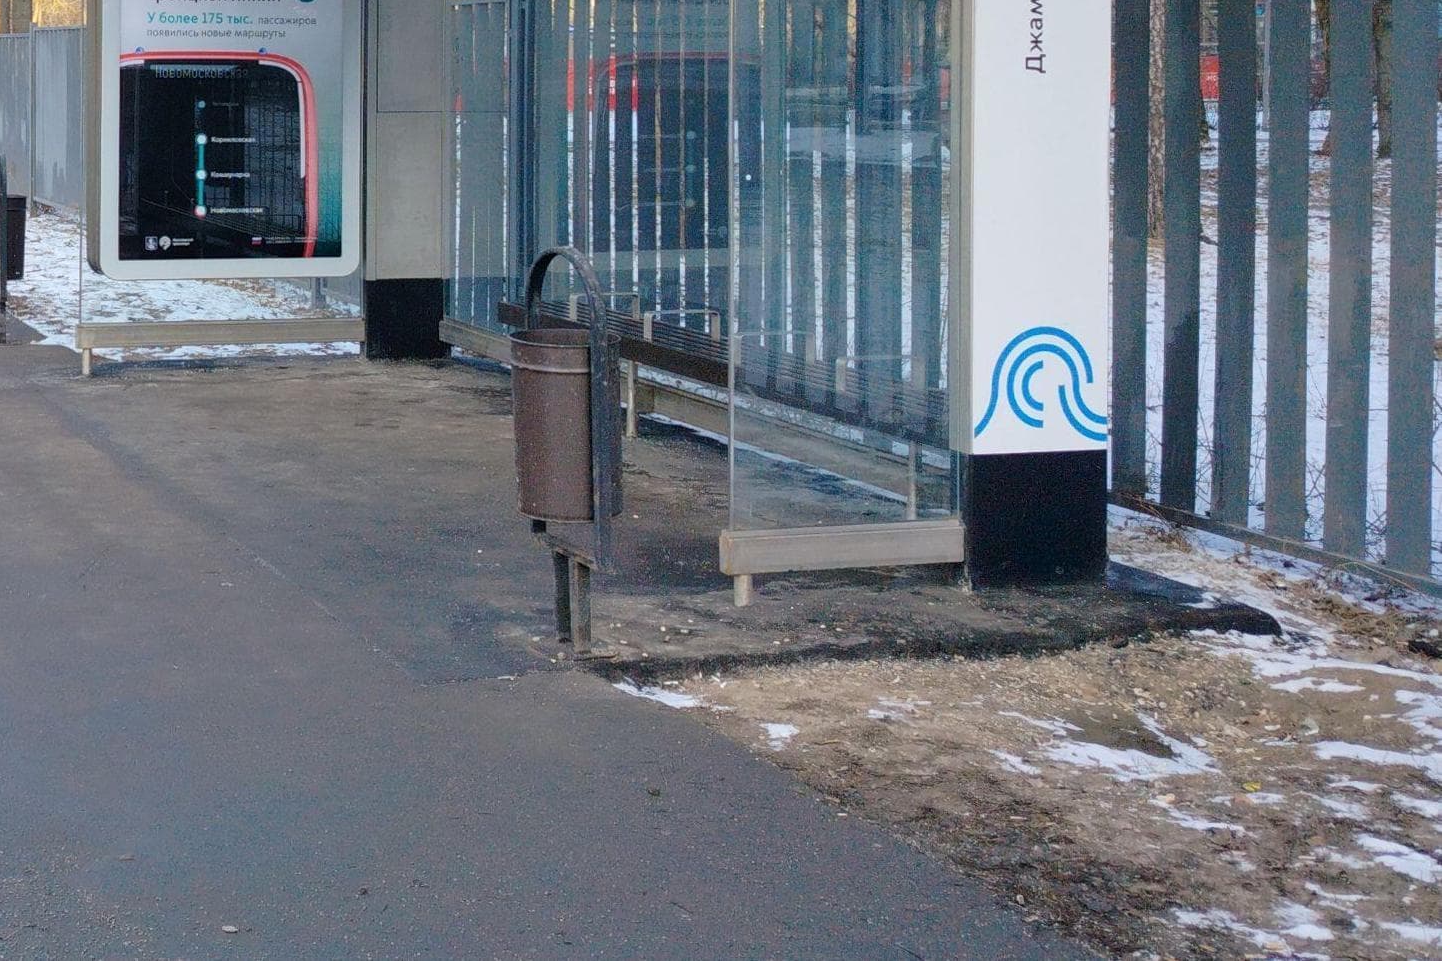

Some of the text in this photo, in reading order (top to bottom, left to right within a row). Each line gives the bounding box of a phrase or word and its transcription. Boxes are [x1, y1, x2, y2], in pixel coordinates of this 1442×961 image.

[159, 12, 198, 24] более
[202, 12, 223, 24] 175
[227, 15, 253, 24] тыс.
[258, 17, 317, 26] пассажиров
[147, 29, 198, 37] появились
[234, 30, 286, 39] маршруты
